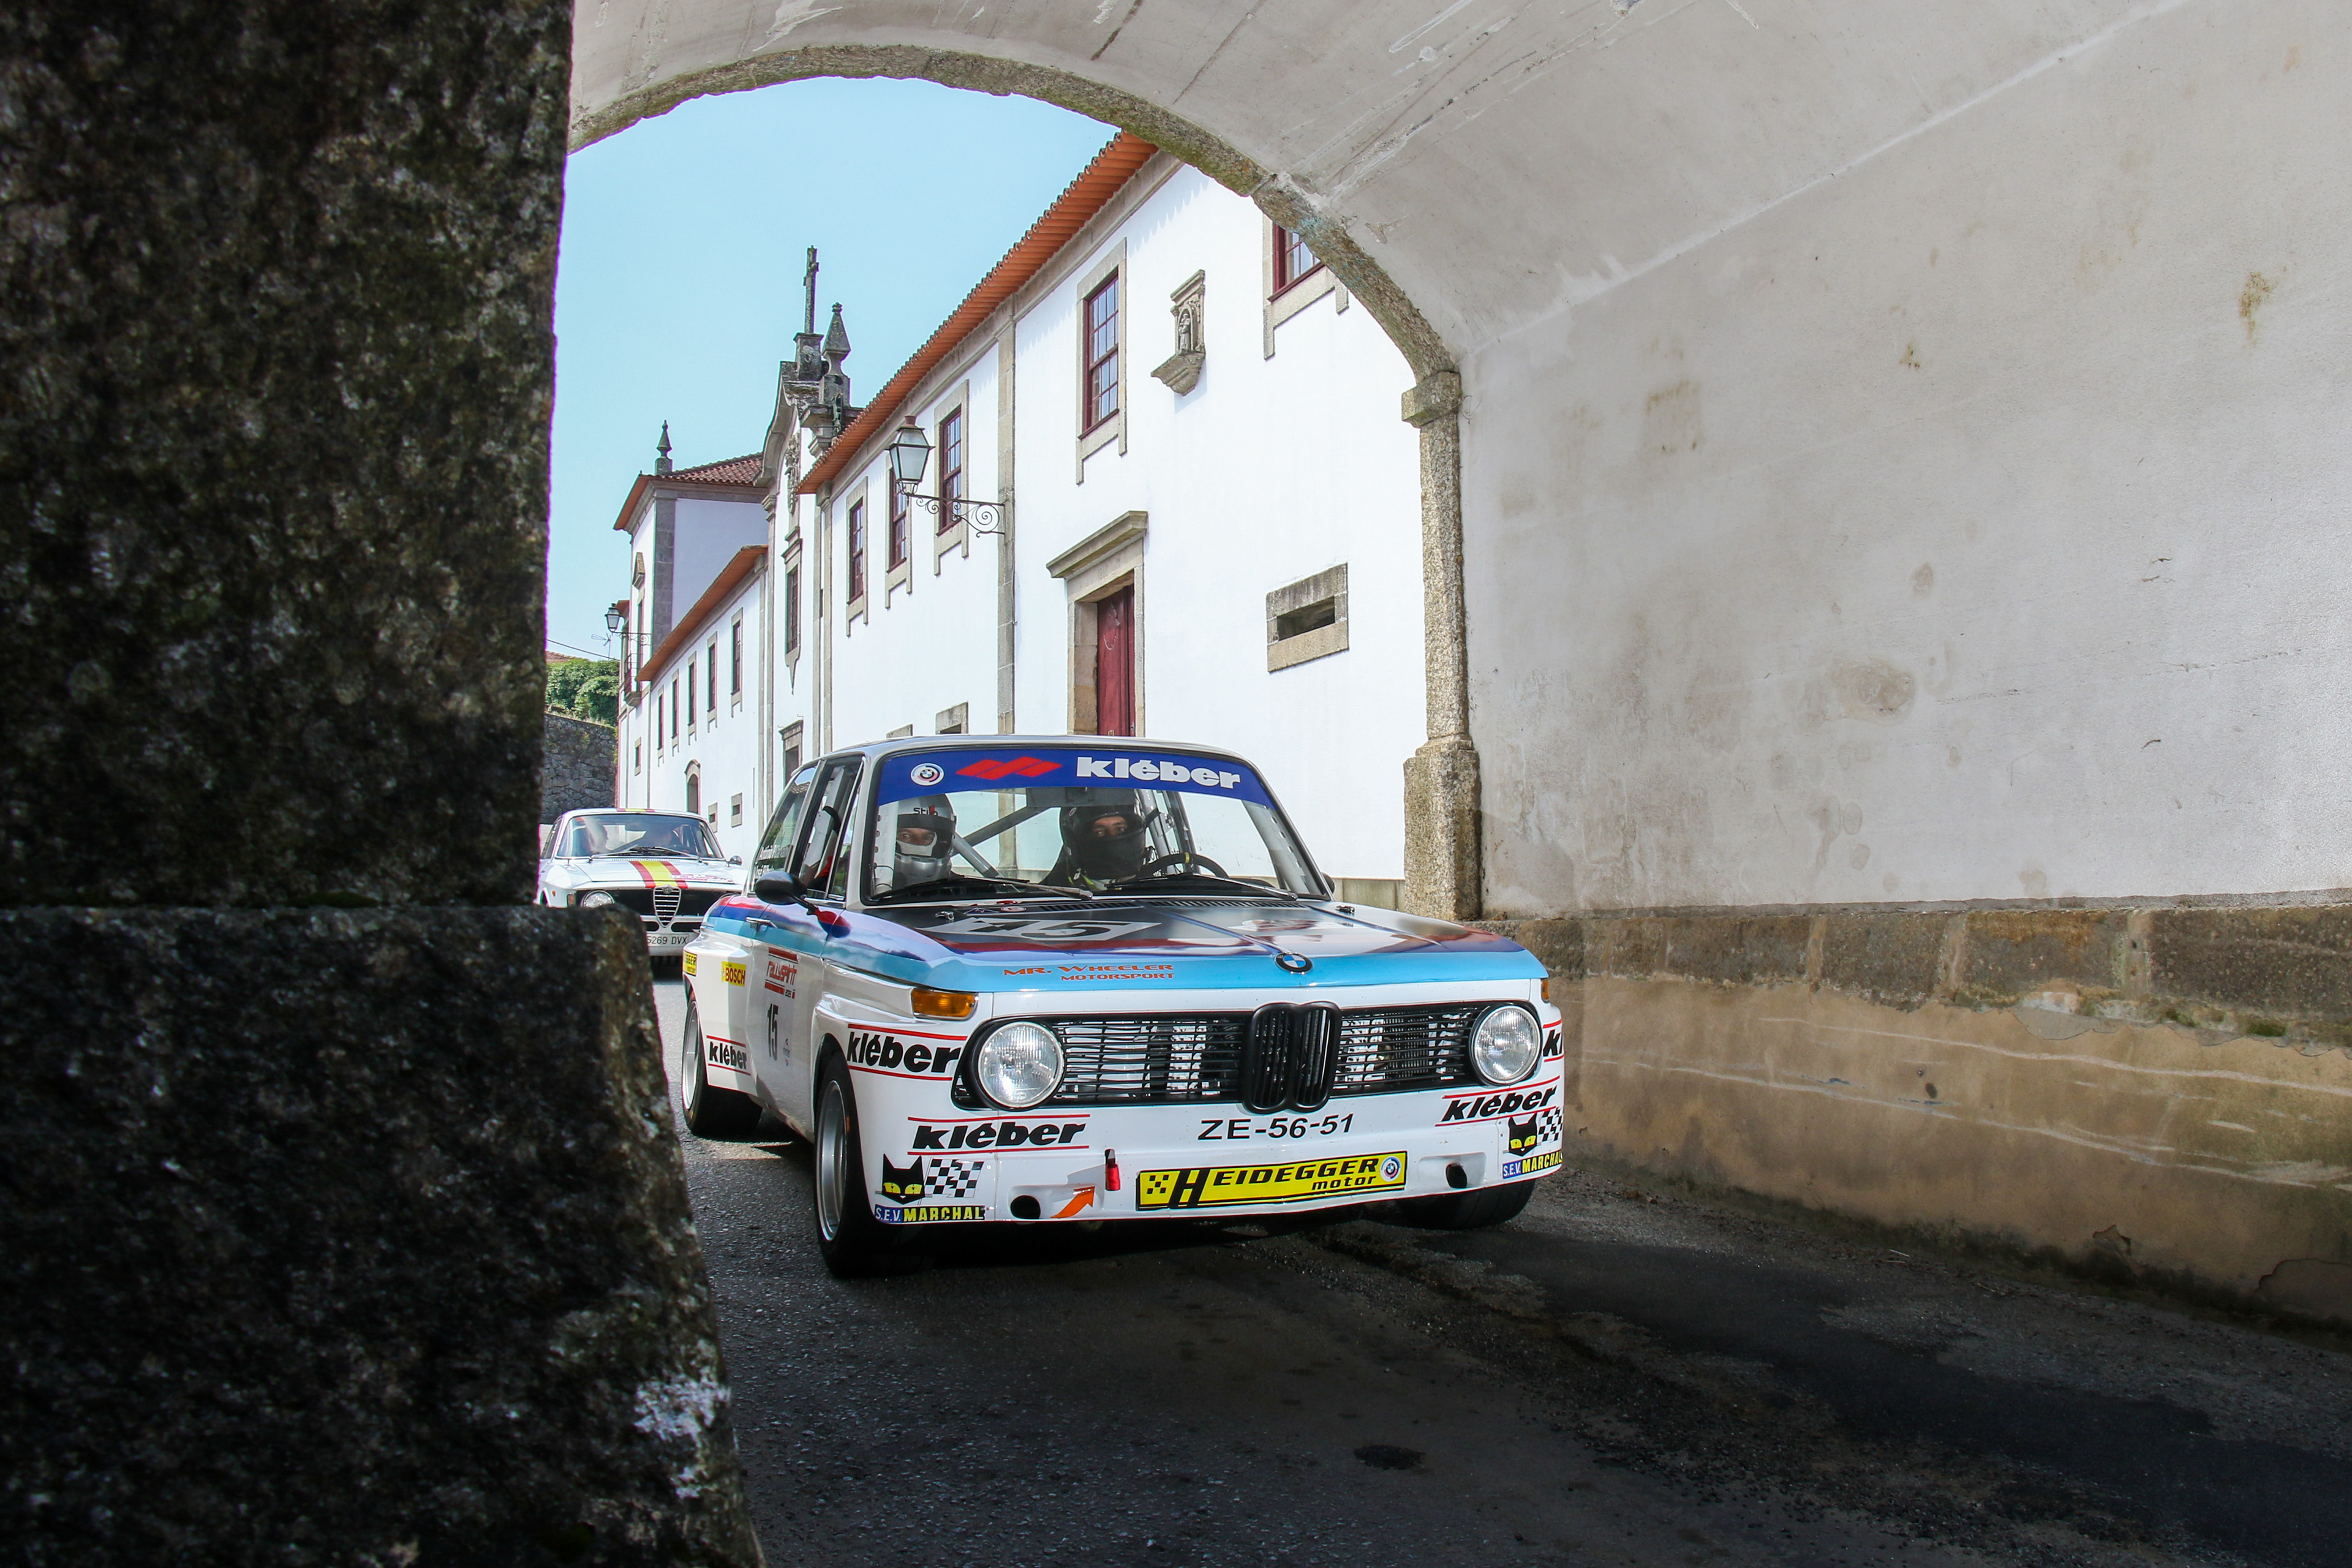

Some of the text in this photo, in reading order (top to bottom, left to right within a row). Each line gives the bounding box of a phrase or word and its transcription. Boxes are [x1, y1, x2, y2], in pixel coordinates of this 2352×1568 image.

[1076, 756, 1241, 790] kléber
[647, 936, 668, 944] 5269
[725, 967, 745, 985] BOSCH
[1004, 967, 1052, 976] MR.
[767, 1003, 778, 1061] 15
[709, 1041, 747, 1069] kléber
[847, 1032, 961, 1073] kléber
[1441, 1085, 1558, 1122] kléber
[912, 1122, 1087, 1150] kléber
[1197, 1113, 1354, 1140] ZE-56-51
[1503, 1152, 1562, 1177] S.E.V. MARCHAL
[1167, 1158, 1379, 1209] HEIDEGGER
[1311, 1174, 1376, 1191] motor
[875, 1207, 984, 1222] S.E.V. MARCHAL
